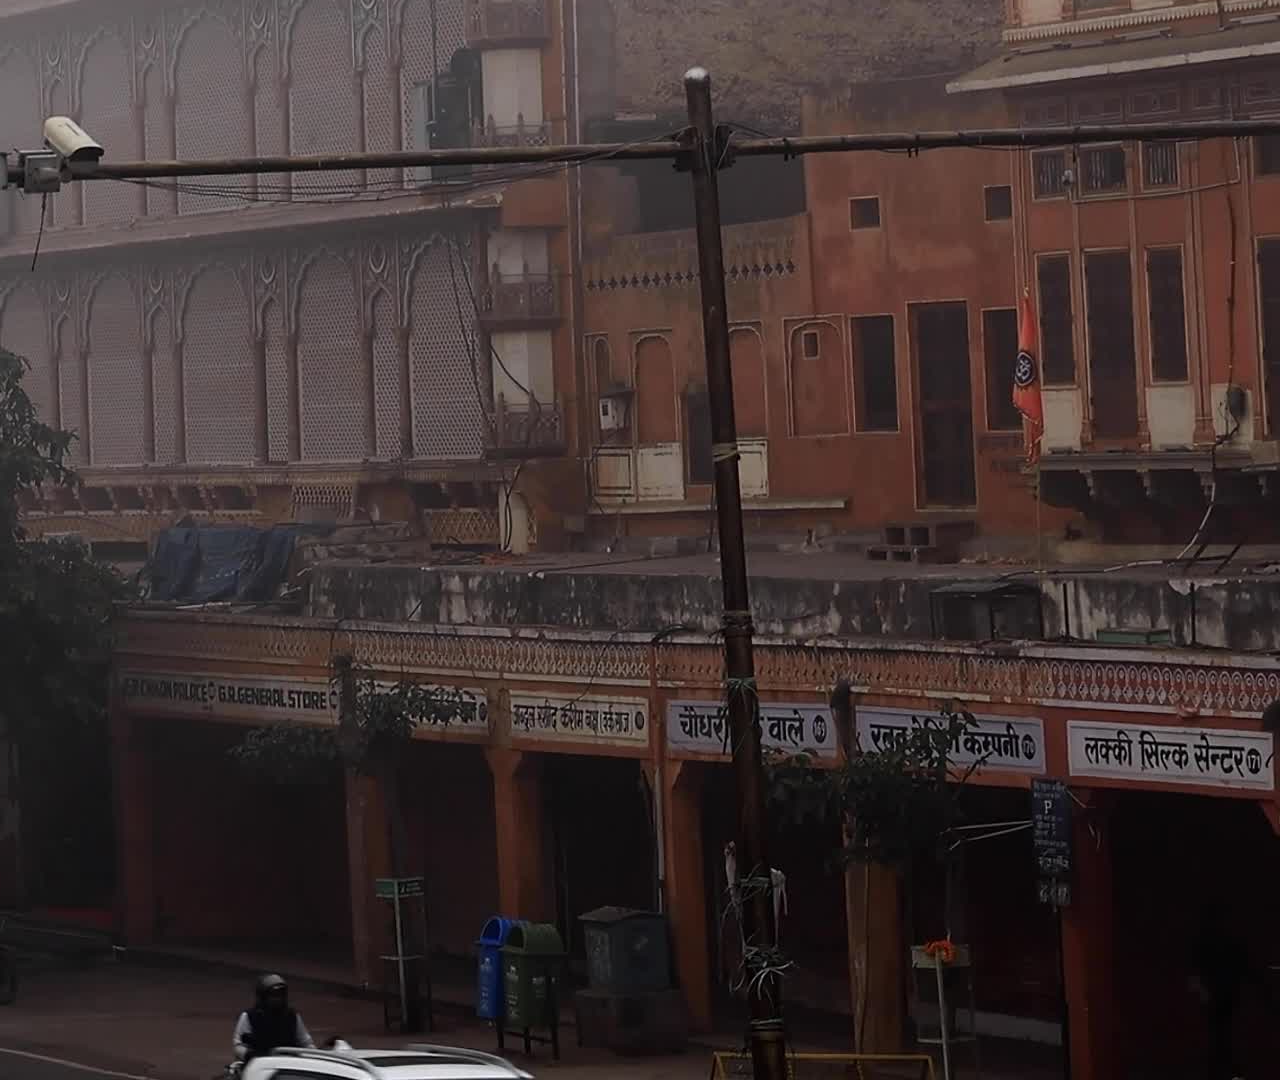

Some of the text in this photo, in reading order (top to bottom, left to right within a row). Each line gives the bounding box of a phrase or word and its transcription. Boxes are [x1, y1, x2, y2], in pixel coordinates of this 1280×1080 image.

[288, 689, 327, 710] STORE
[768, 709, 804, 745] वाले
[963, 723, 1020, 759] कम्पनी
[1085, 730, 1133, 766] लक्की
[1139, 730, 1189, 770] सिल्क
[1194, 732, 1245, 777] सेन्टर
[1044, 799, 1052, 814] P
